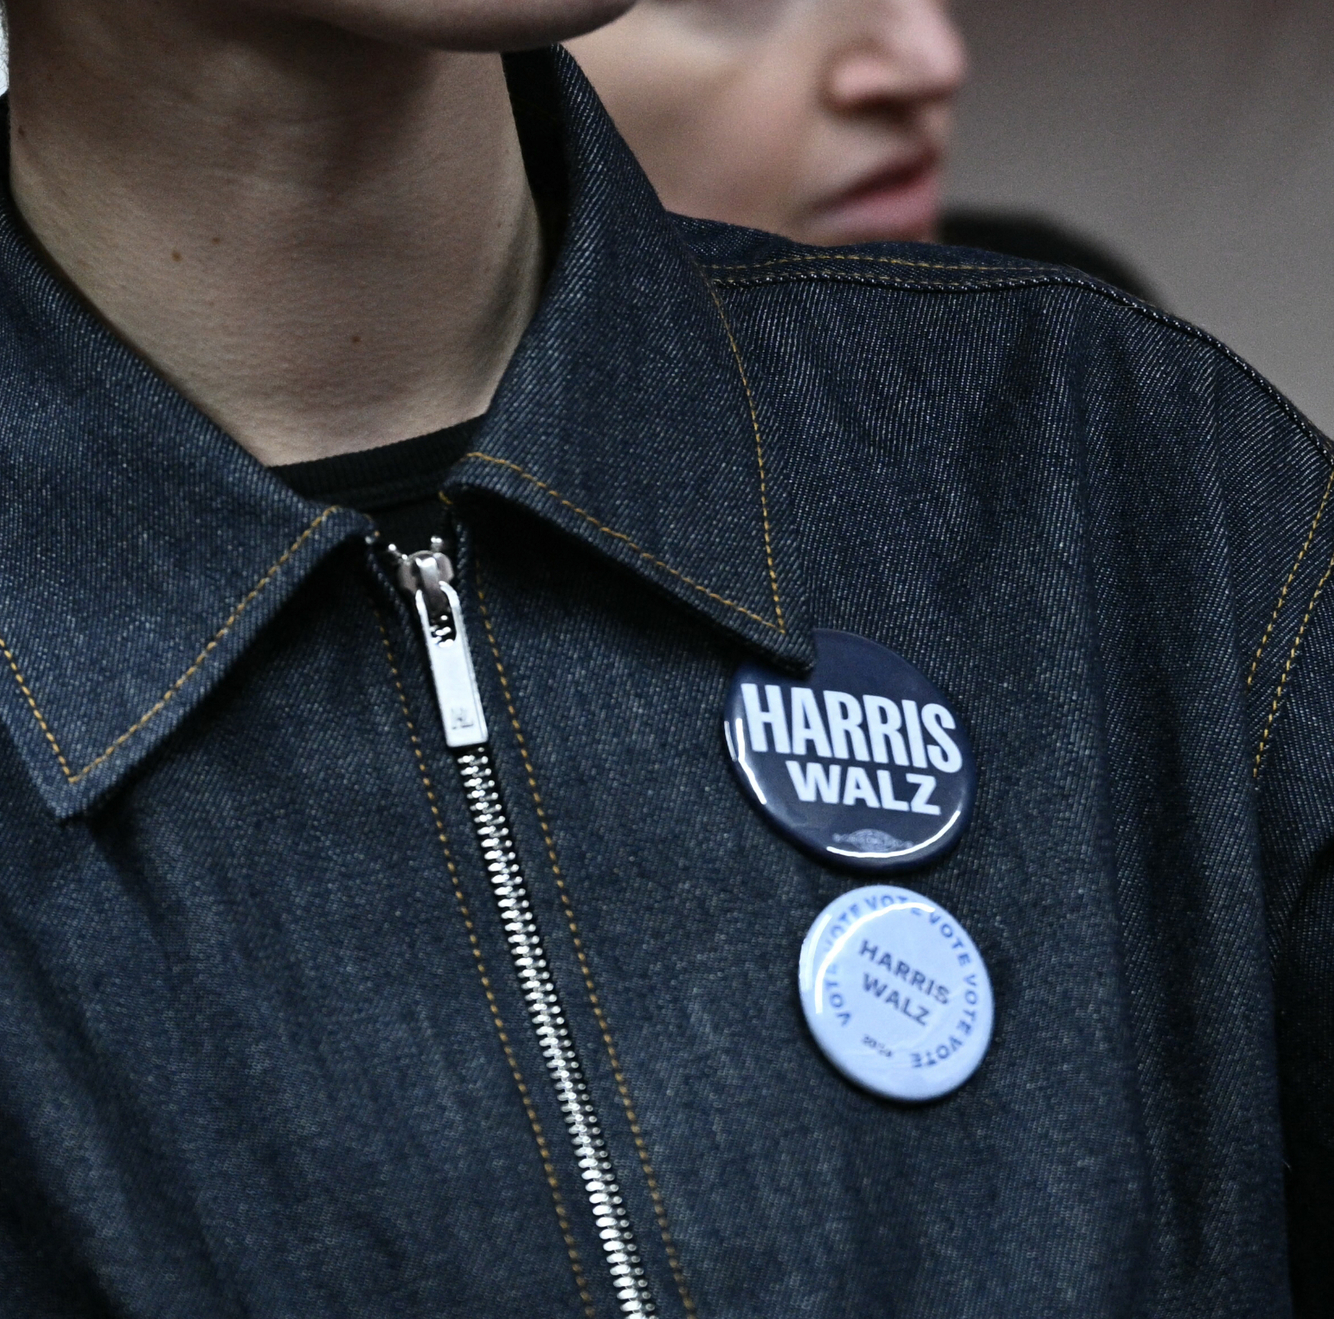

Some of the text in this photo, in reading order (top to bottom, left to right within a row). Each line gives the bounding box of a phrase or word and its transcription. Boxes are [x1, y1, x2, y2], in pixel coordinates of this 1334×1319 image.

[741, 683, 963, 774] HARRIS
[786, 761, 941, 816] WALZ
[928, 912, 972, 968] VOTE
[858, 940, 952, 1005] HARRIS
[863, 973, 930, 1027] WALZ
[956, 973, 980, 1037] VOTE
[911, 1036, 964, 1069] VOTE
